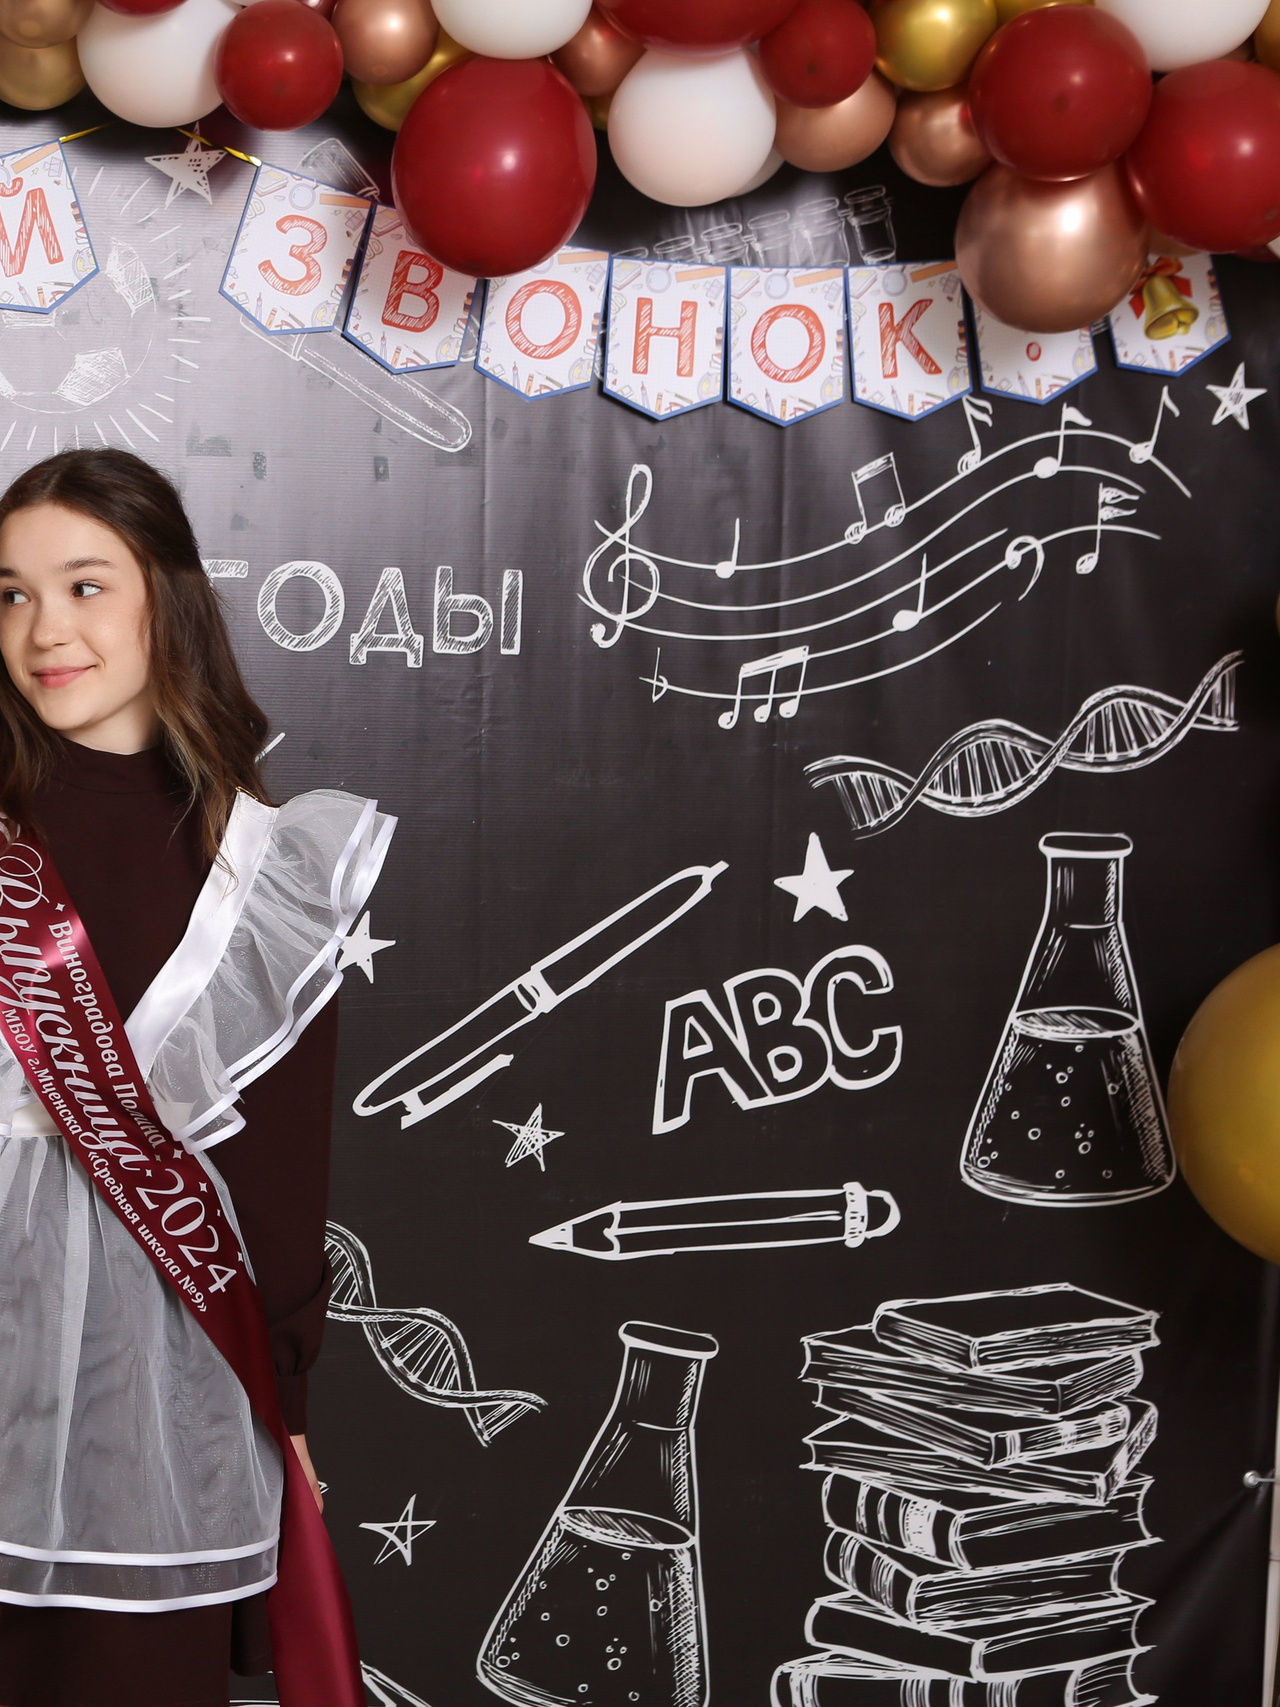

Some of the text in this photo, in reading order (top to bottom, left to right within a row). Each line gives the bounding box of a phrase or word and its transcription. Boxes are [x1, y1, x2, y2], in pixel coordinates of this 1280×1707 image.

[258, 214, 1043, 383] ЗВОНОК
[48, 920, 167, 1149] Виноградова Полина
[652, 944, 903, 1134] ABC
[2, 1008, 207, 1312] МБОУ г.Мценска «Средняя школа №9»
[136, 1168, 237, 1294] 2024
